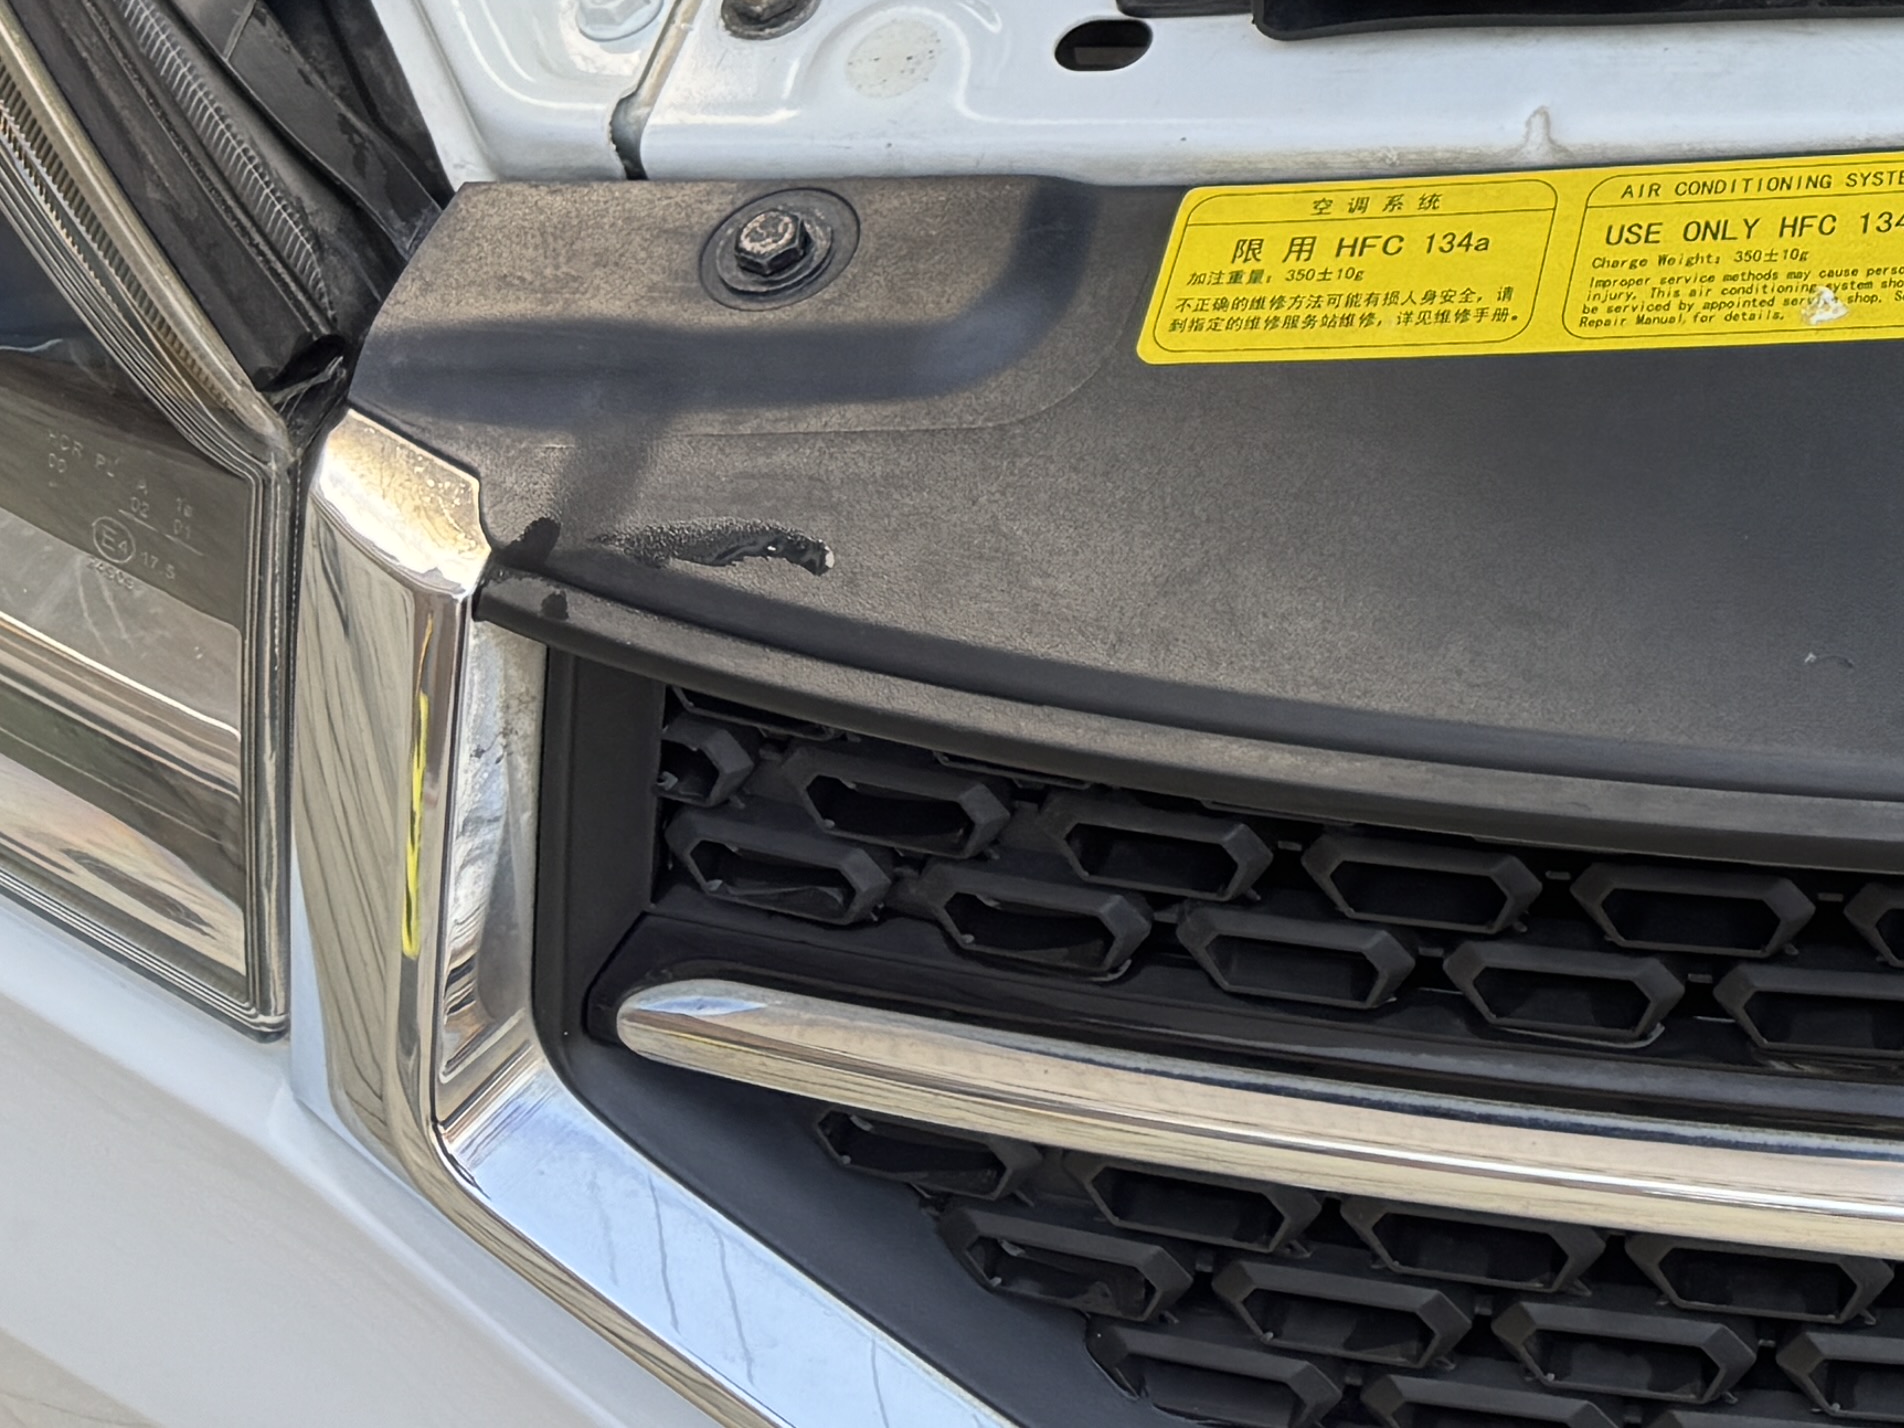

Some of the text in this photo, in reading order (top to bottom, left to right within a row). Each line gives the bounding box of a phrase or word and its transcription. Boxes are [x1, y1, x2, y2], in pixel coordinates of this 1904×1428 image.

[1621, 183, 1660, 199] AIR
[1675, 174, 1832, 196] CONDITIONING
[1311, 193, 1442, 216] 空调系统
[1605, 222, 1663, 245] USE
[1683, 217, 1761, 241] ONLY
[1779, 214, 1837, 238] HFC
[1335, 235, 1404, 258] HFC
[1425, 231, 1490, 255] 134a
[1592, 257, 1648, 270] Charge
[1658, 253, 1720, 267] Weight:
[1590, 276, 1651, 289] Improper
[1660, 273, 1715, 285] service
[1723, 269, 1778, 282] methods
[1786, 270, 1811, 282] may
[1819, 267, 1858, 279] cause
[1582, 304, 1598, 314] be
[1606, 301, 1671, 314] serviced
[1678, 300, 1694, 312] by
[1702, 297, 1775, 310] appointed
[1847, 292, 1882, 305] shop.
[1587, 290, 1636, 304] injury.
[1651, 287, 1680, 299] This
[1689, 285, 1712, 297] air
[1721, 281, 1818, 296] conditioning
[1579, 316, 1627, 329] Repair
[1693, 311, 1715, 323] for
[1724, 309, 1785, 323] details.
